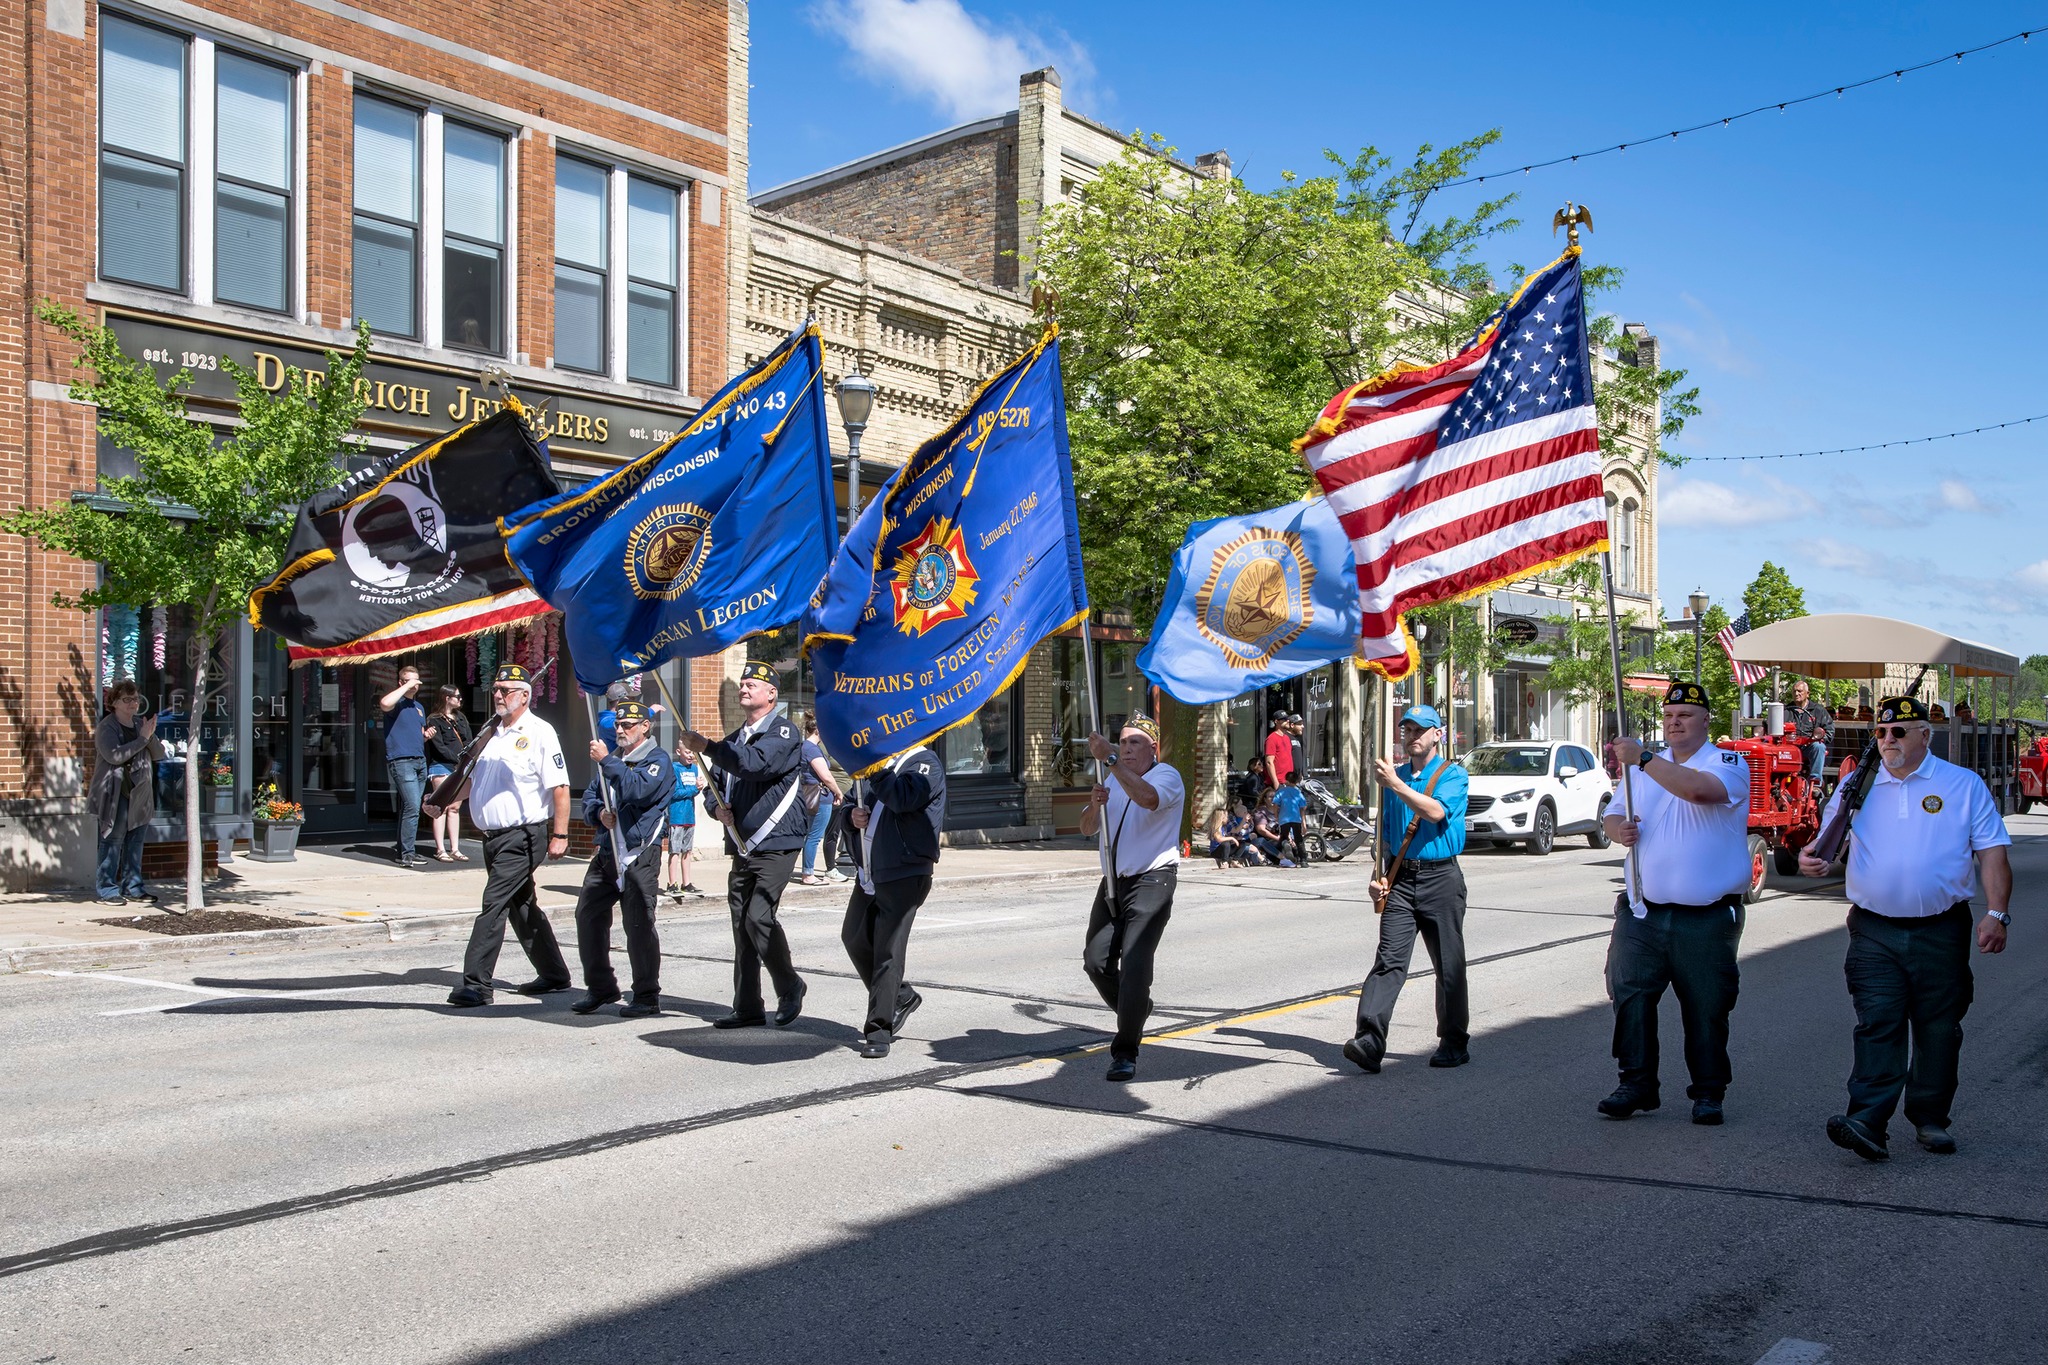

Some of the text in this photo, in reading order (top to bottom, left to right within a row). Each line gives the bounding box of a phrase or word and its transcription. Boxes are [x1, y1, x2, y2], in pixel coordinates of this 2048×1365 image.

[143, 348, 217, 371] est. 1923
[763, 391, 786, 410] 43
[629, 427, 649, 440] est.
[641, 447, 720, 495] WISCONSIN
[904, 463, 955, 519] WISCONSIN
[979, 516, 1012, 550] January
[695, 583, 778, 632] LEGION
[833, 671, 915, 695] VETERANS
[934, 611, 1001, 680] FOREIGN
[921, 669, 983, 715] UNITED
